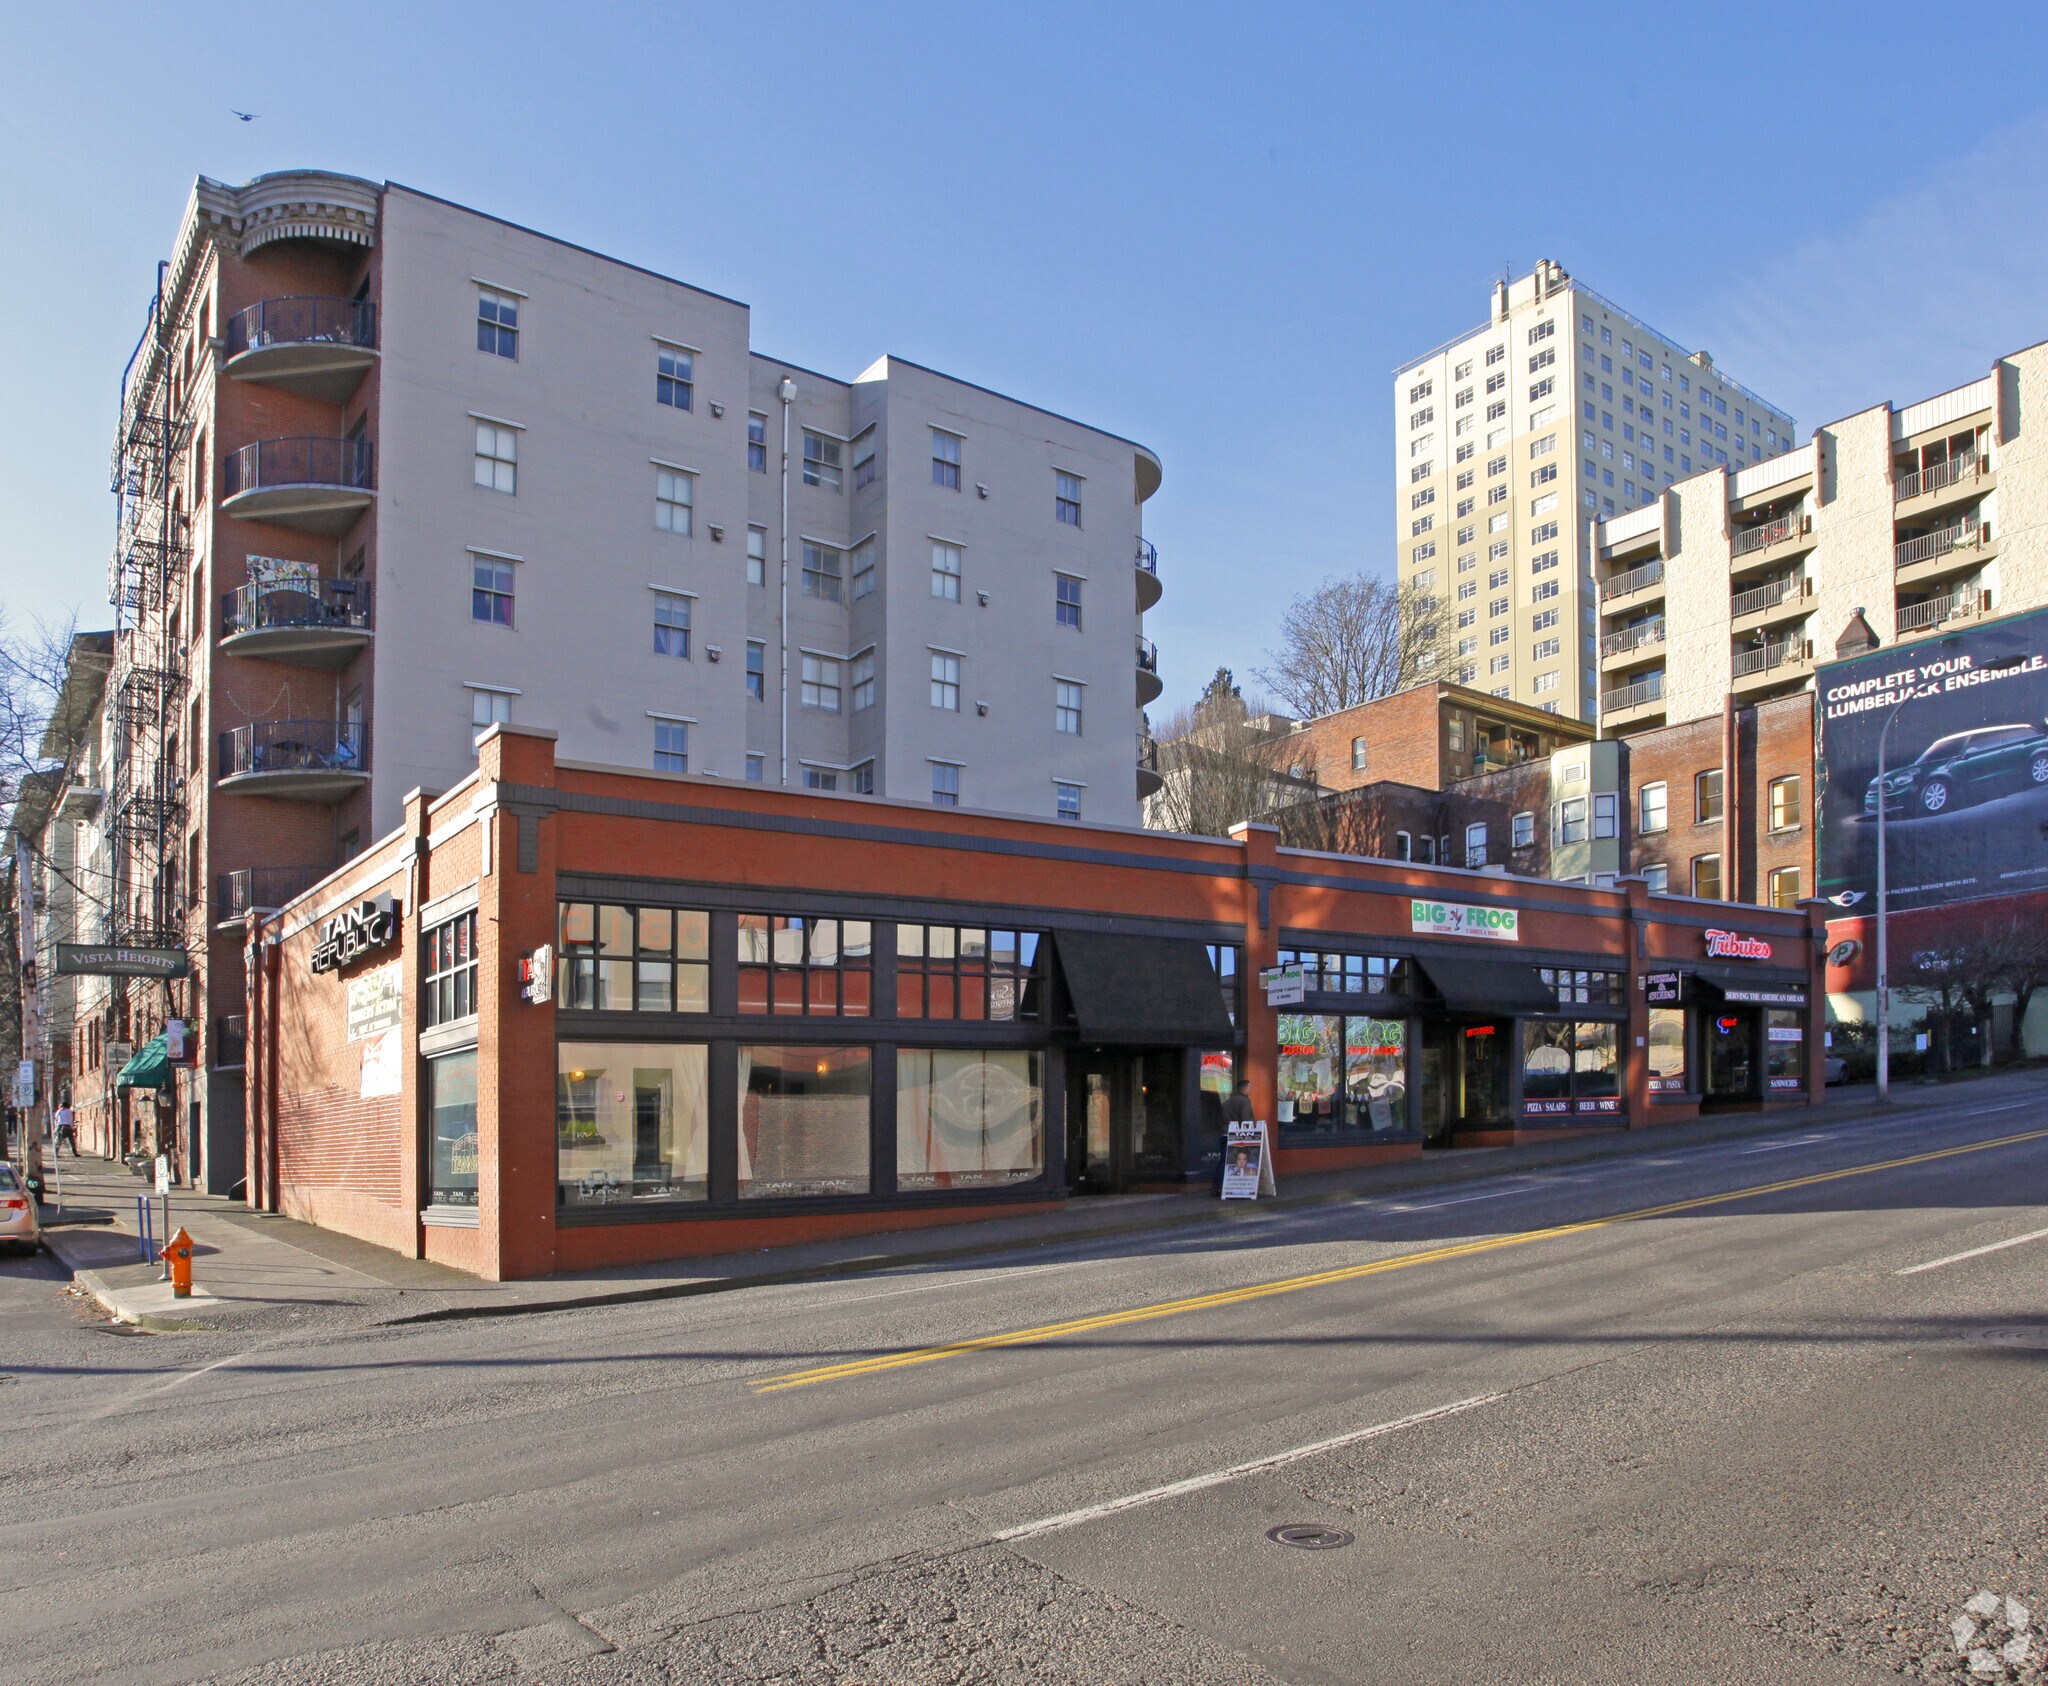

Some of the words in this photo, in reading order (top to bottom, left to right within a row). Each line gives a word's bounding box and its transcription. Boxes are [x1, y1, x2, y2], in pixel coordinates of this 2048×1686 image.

[1827, 668, 1915, 702] COMPLETE
[1919, 655, 1972, 680] YOUR
[1827, 682, 1941, 719] LUMBERJACK
[1921, 881, 1944, 891] DESIGN
[1945, 879, 1962, 888] WITH
[1962, 877, 1979, 886] BITE.
[323, 900, 364, 943] TAN
[1412, 902, 1447, 924] BIG
[1466, 907, 1516, 930] FROG
[311, 917, 381, 971] REPUBLIC
[1705, 928, 1773, 959] Tributes
[72, 953, 113, 964] VISTA
[116, 950, 175, 969] HEIGHTS
[1284, 970, 1300, 979] FROG
[1647, 972, 1677, 984] PIZZA
[1657, 982, 1666, 991] &
[1648, 989, 1676, 1001] SUBS
[1726, 991, 1749, 1000] SERVING
[1749, 992, 1760, 1001] THE
[1761, 993, 1786, 1002] AMERICAN
[1786, 994, 1805, 1002] DREAM
[1278, 1018, 1317, 1046] BIG
[1282, 1044, 1316, 1056] CUSTOM
[1649, 1080, 1662, 1090] PIZZA
[1666, 1079, 1682, 1089] PASTA
[1770, 1079, 1798, 1088] SANDWICHES
[1527, 1102, 1542, 1112] PIZZA
[1545, 1101, 1567, 1111] SALADS
[1579, 1101, 1596, 1111] BEER
[1599, 1100, 1615, 1110] WINE
